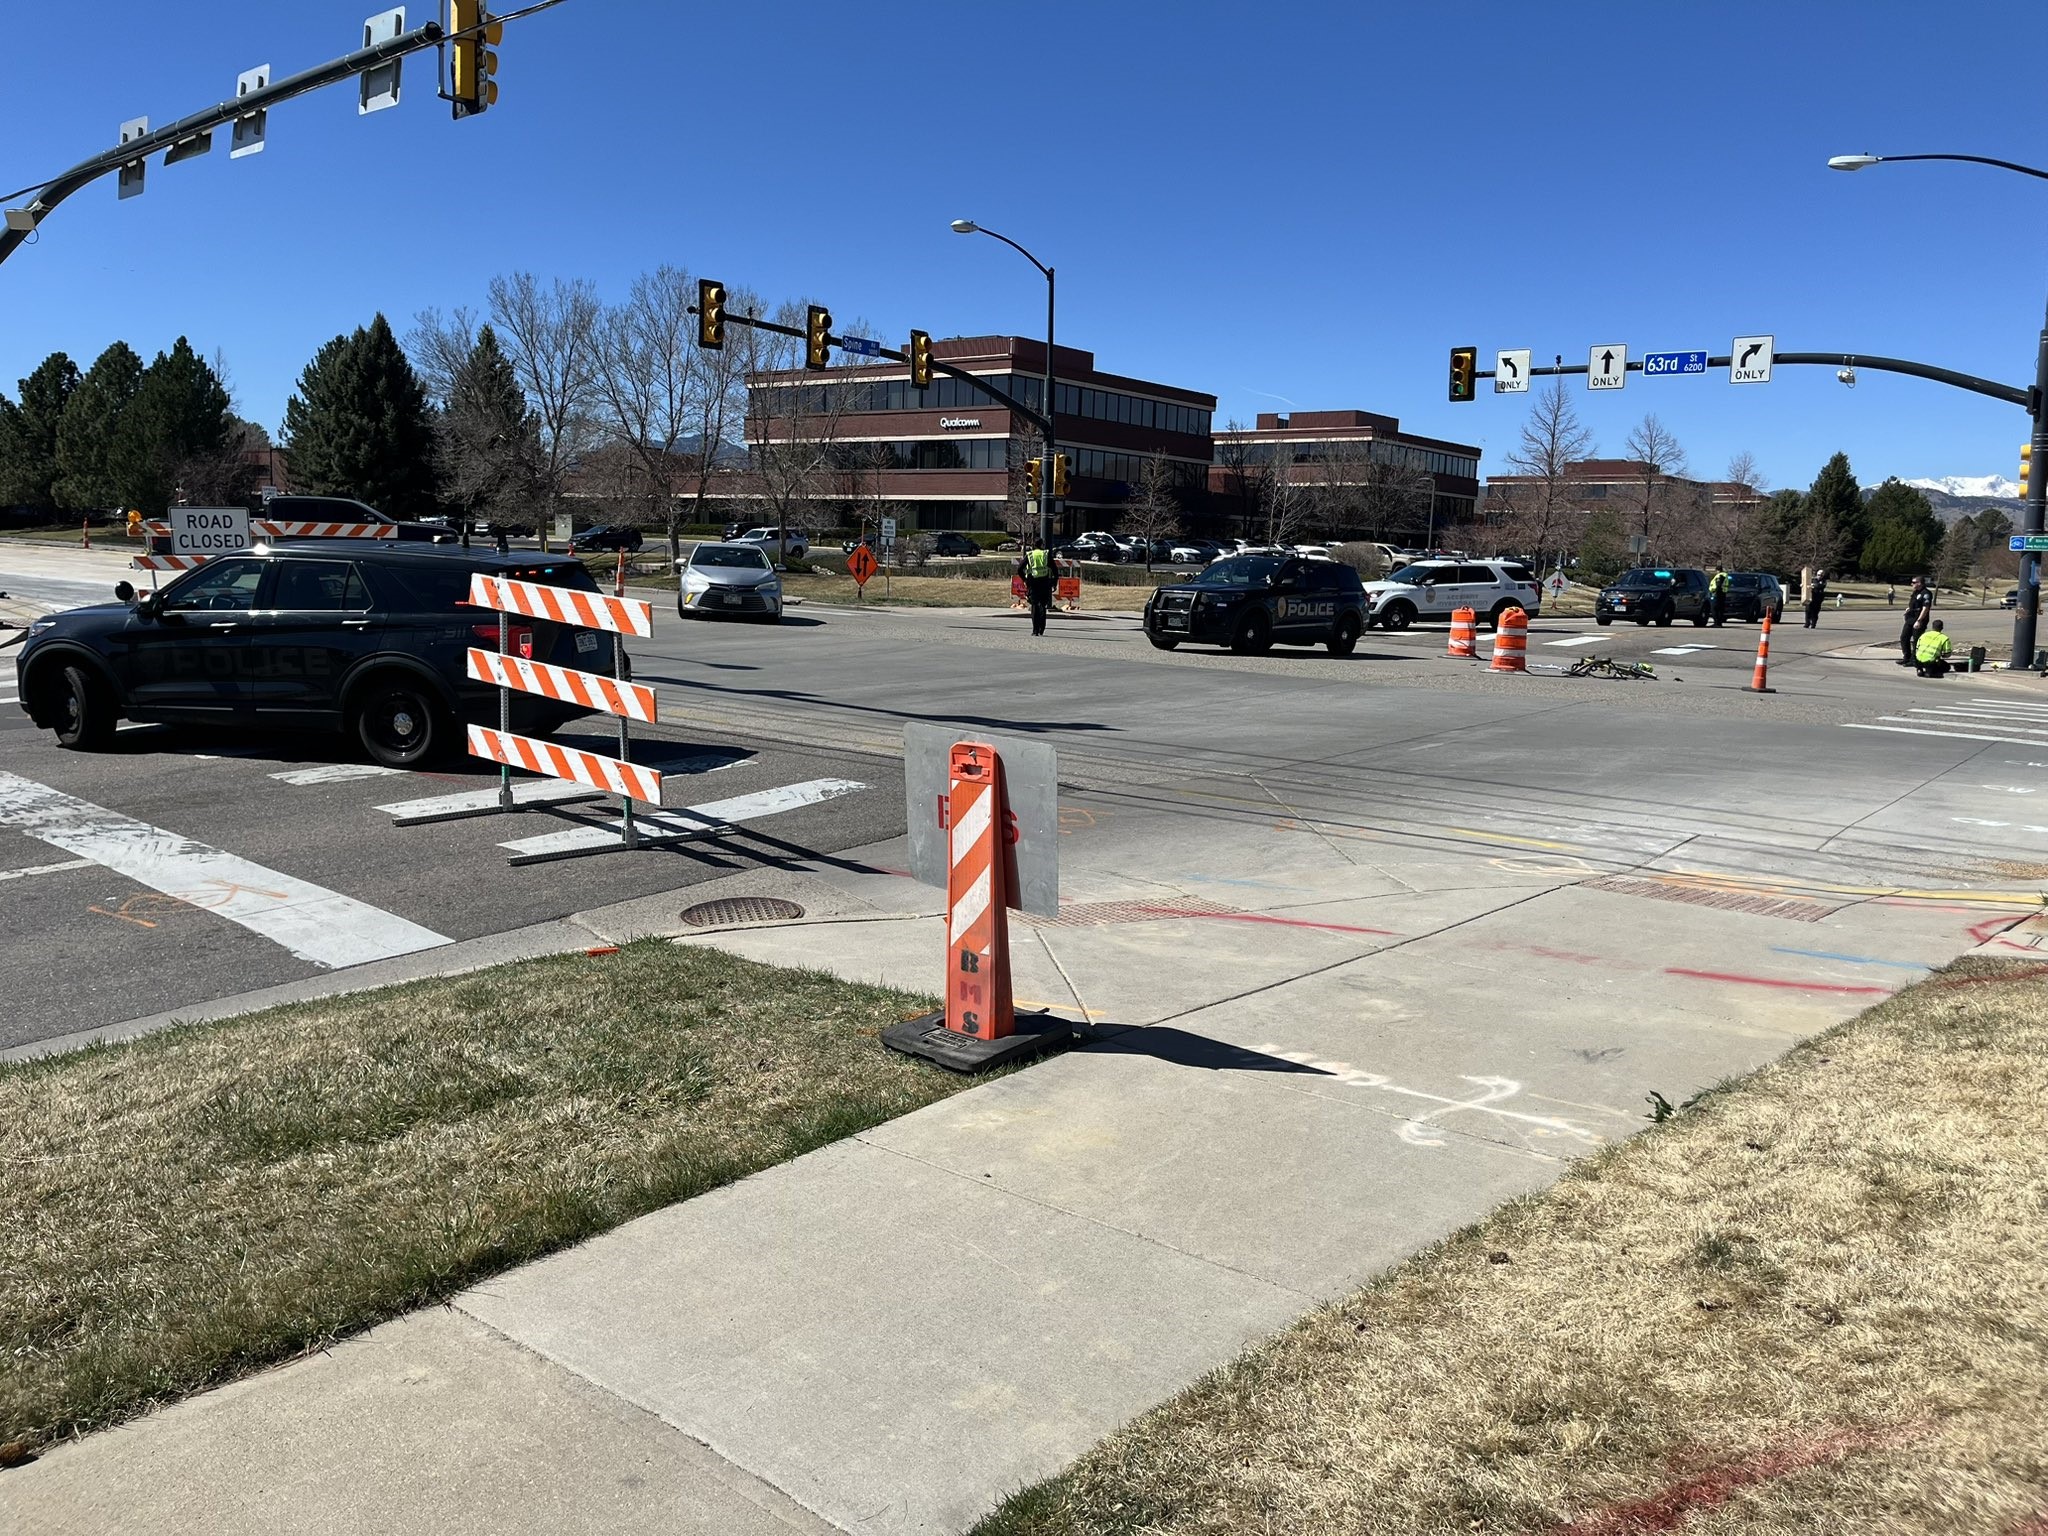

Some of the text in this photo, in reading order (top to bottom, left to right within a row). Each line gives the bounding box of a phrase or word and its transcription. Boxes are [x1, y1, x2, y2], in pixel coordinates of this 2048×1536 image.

[844, 337, 862, 351] Spine
[1647, 353, 1698, 372] 63rd St
[1683, 362, 1703, 371] 6200
[1735, 369, 1766, 380] ONLY
[1500, 380, 1522, 390] ONLY
[1592, 376, 1620, 387] ONLY
[940, 417, 980, 428] Qualcomm
[186, 514, 233, 529] ROAD
[179, 534, 244, 549] CLOSED
[1287, 602, 1335, 617] POLICE
[443, 626, 467, 639] 911
[172, 646, 331, 677] POLICE
